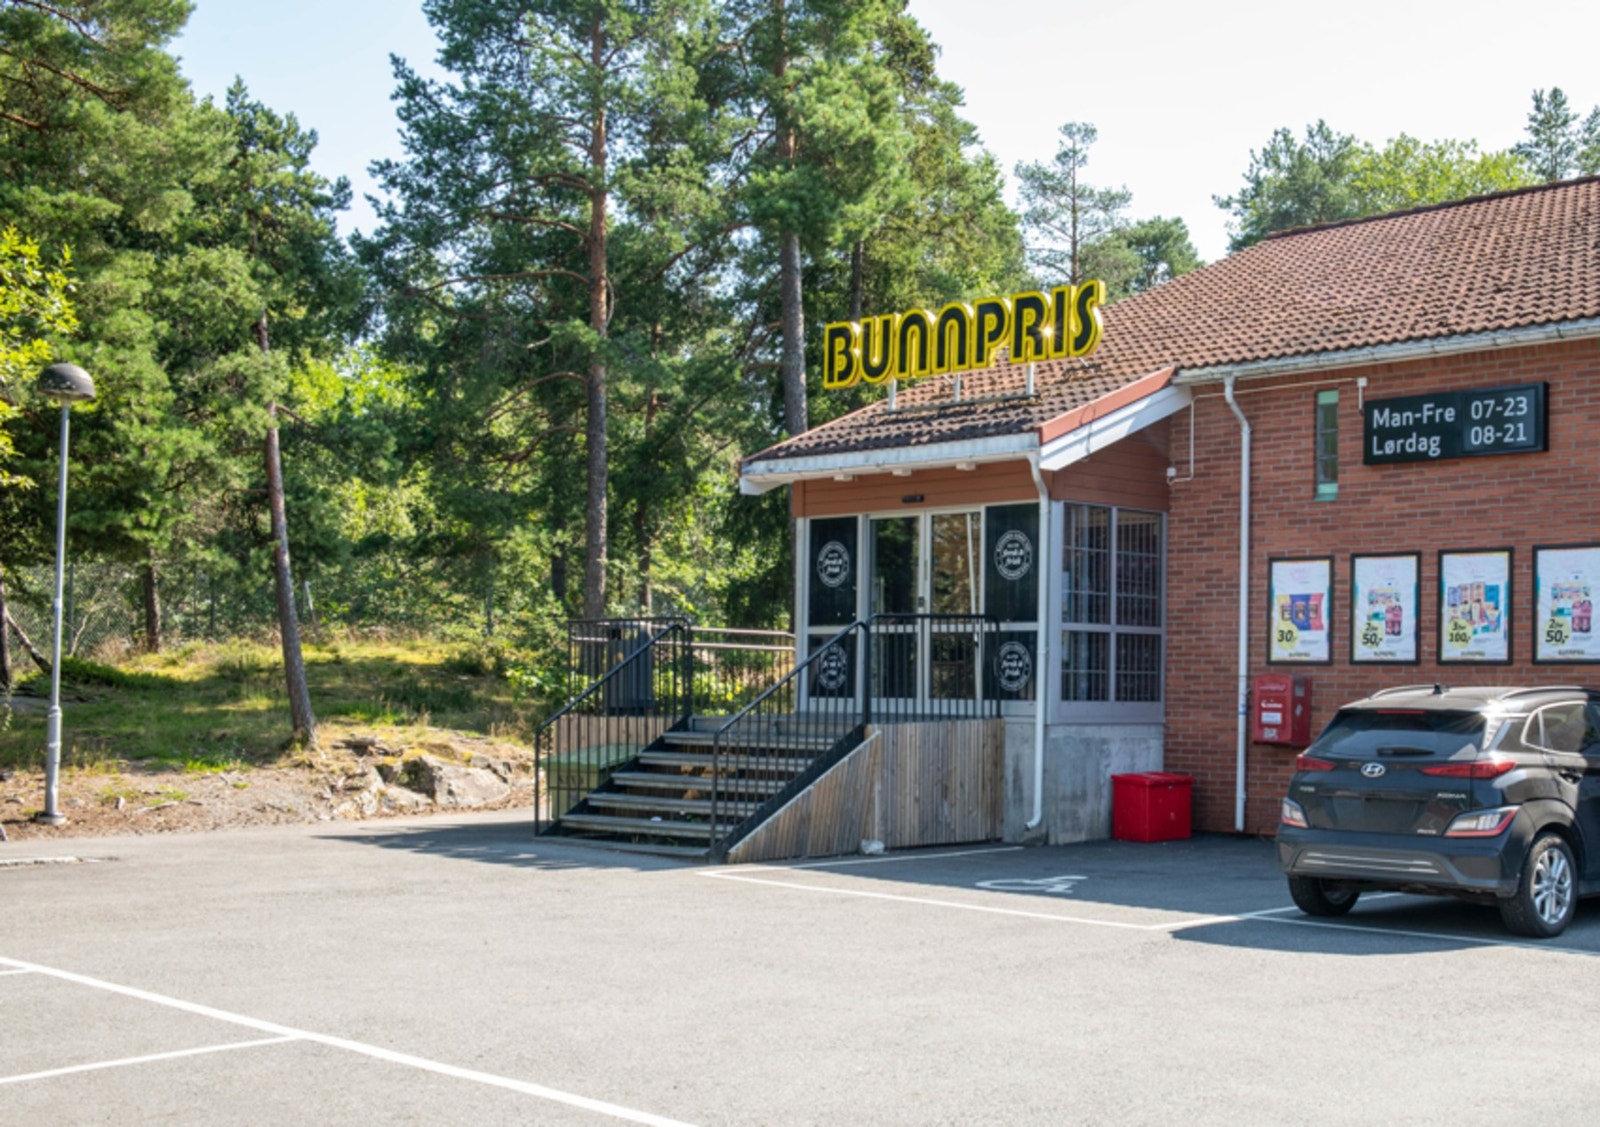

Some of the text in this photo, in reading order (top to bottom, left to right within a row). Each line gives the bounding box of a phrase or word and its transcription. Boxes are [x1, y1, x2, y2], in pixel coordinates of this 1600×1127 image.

[823, 279, 1105, 389] BUNNPRIS
[1373, 396, 1528, 429] Man-Fre 07-23
[1372, 423, 1527, 457] Lørdag 08-21
[1545, 629, 1569, 644] 50,-
